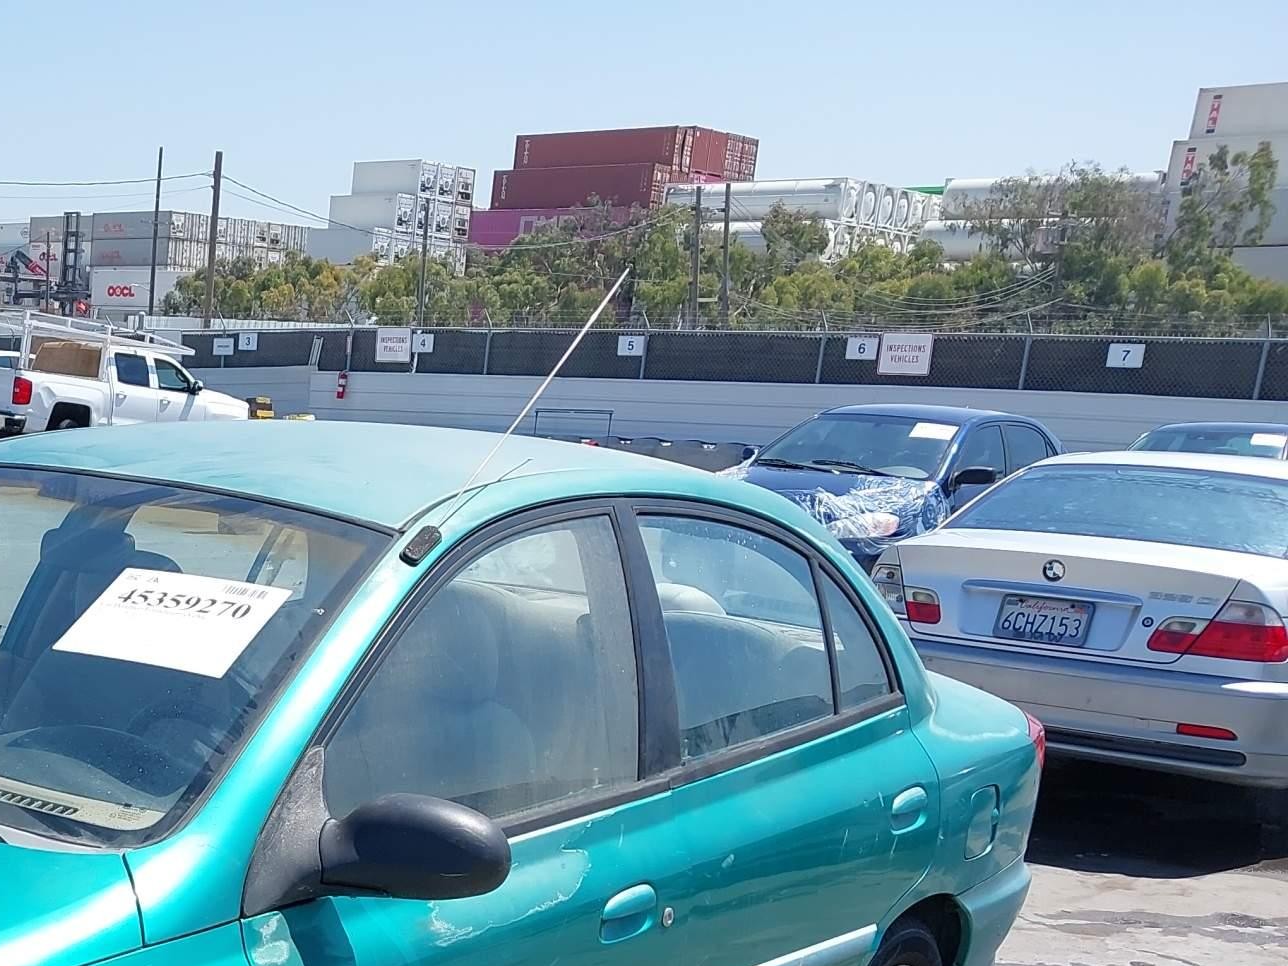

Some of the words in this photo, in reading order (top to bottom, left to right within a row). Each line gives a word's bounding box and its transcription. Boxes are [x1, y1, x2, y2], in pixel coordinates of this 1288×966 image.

[107, 285, 135, 298] OOCL
[245, 337, 251, 346] 3
[420, 338, 426, 348] 4
[627, 340, 634, 351] 5
[858, 343, 866, 354] 6
[886, 344, 927, 353] INSPECTIONS
[890, 354, 920, 364] VEHICLES
[1122, 350, 1131, 361] 7
[117, 588, 252, 620] 45359270
[1017, 599, 1069, 614] California
[1001, 610, 1082, 639] 6CHZ153
